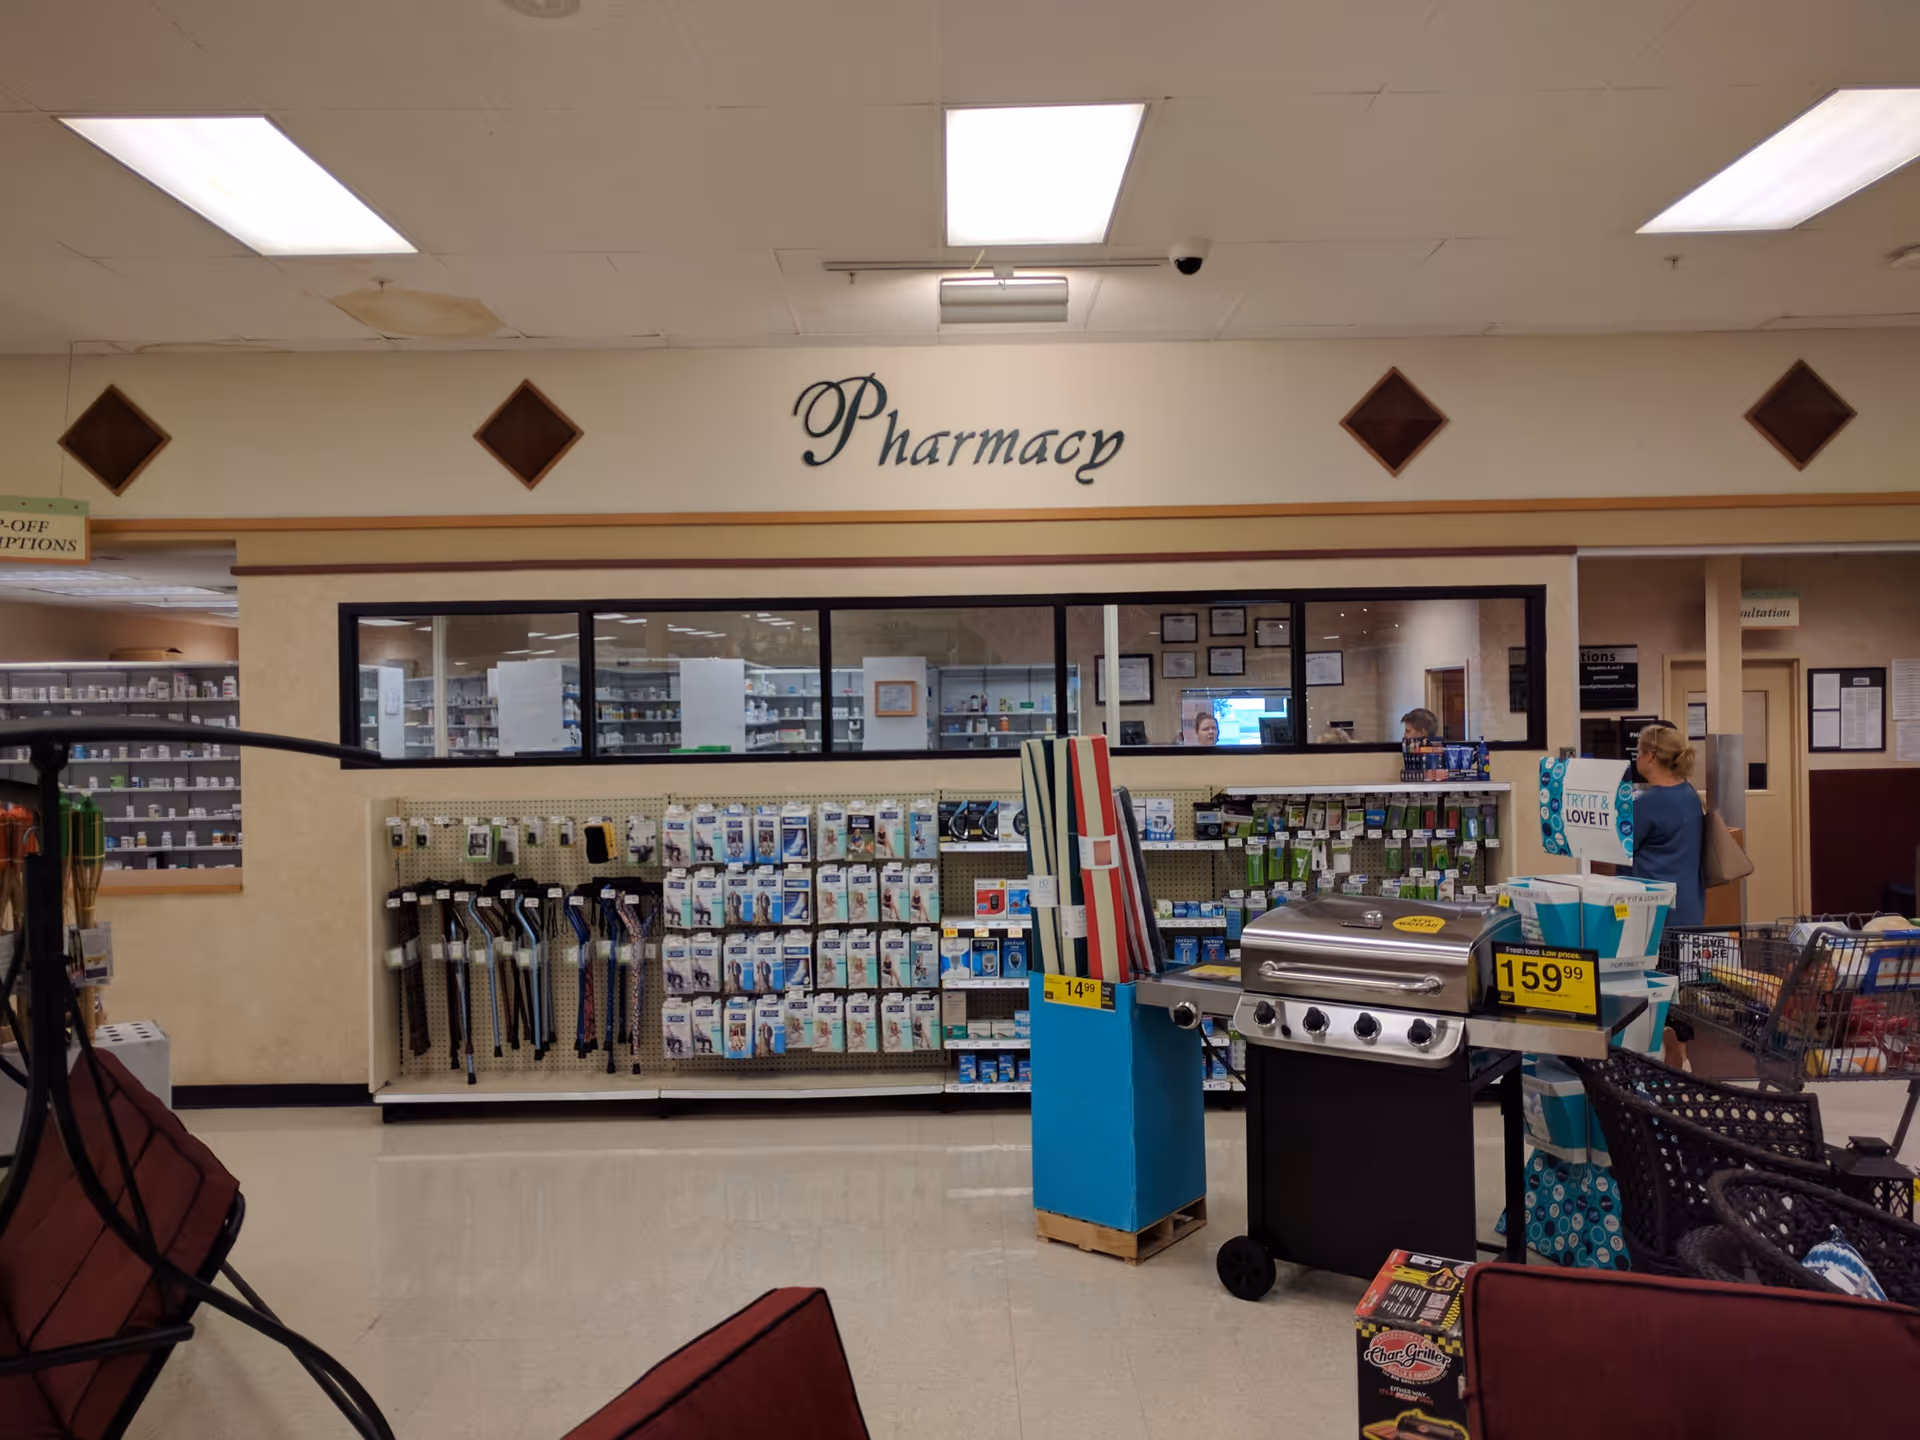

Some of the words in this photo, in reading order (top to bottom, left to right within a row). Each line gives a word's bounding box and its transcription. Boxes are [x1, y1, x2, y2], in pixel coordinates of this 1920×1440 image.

[792, 372, 1125, 485] Pharmacy
[1740, 606, 1790, 618] ultation
[1565, 792, 1586, 808] TRY
[1588, 794, 1599, 809] IT
[1601, 795, 1609, 809] &
[1566, 808, 1596, 825] LOVE
[1599, 812, 1609, 826] IT
[1505, 946, 1524, 955] Fresh
[1541, 949, 1557, 957] Low
